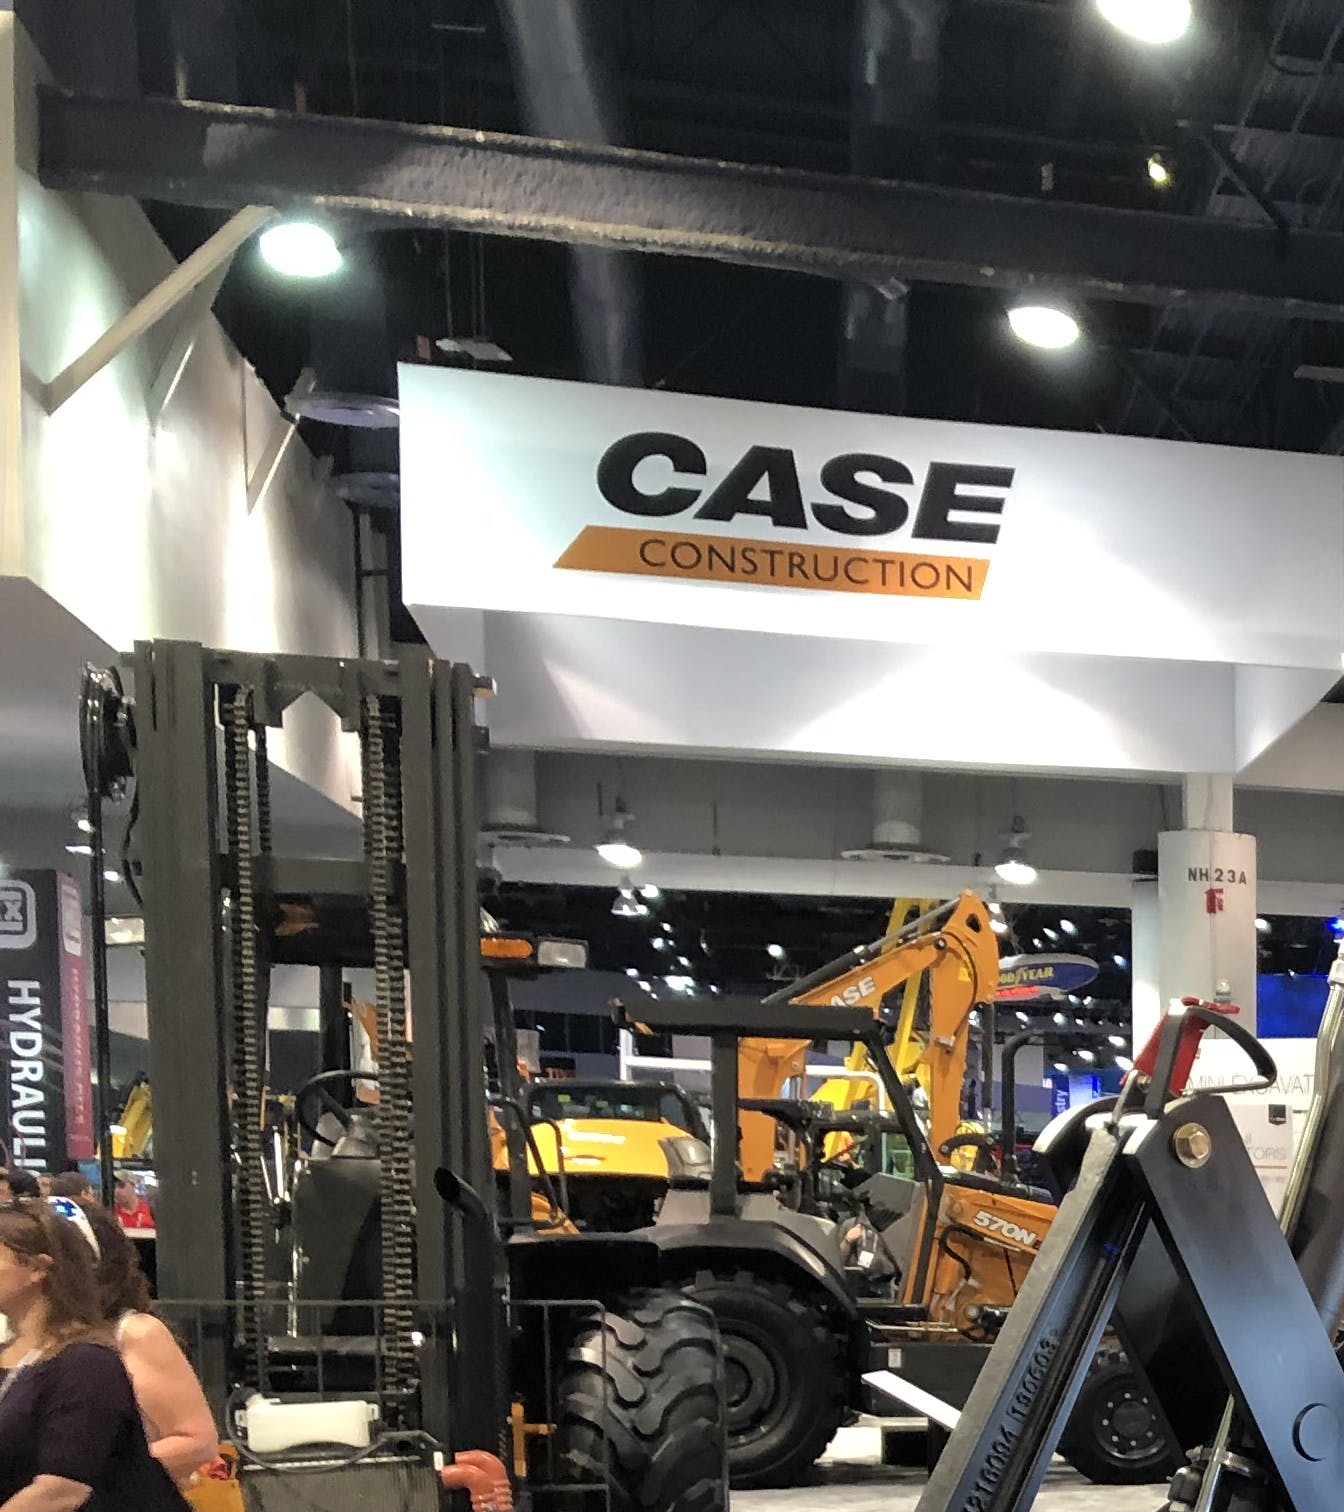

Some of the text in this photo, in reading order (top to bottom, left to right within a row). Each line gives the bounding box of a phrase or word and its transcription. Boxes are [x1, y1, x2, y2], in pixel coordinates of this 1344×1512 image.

[596, 431, 1016, 545] CASE
[639, 538, 974, 592] CONSTRUCTION
[973, 1210, 1037, 1246] 570N
